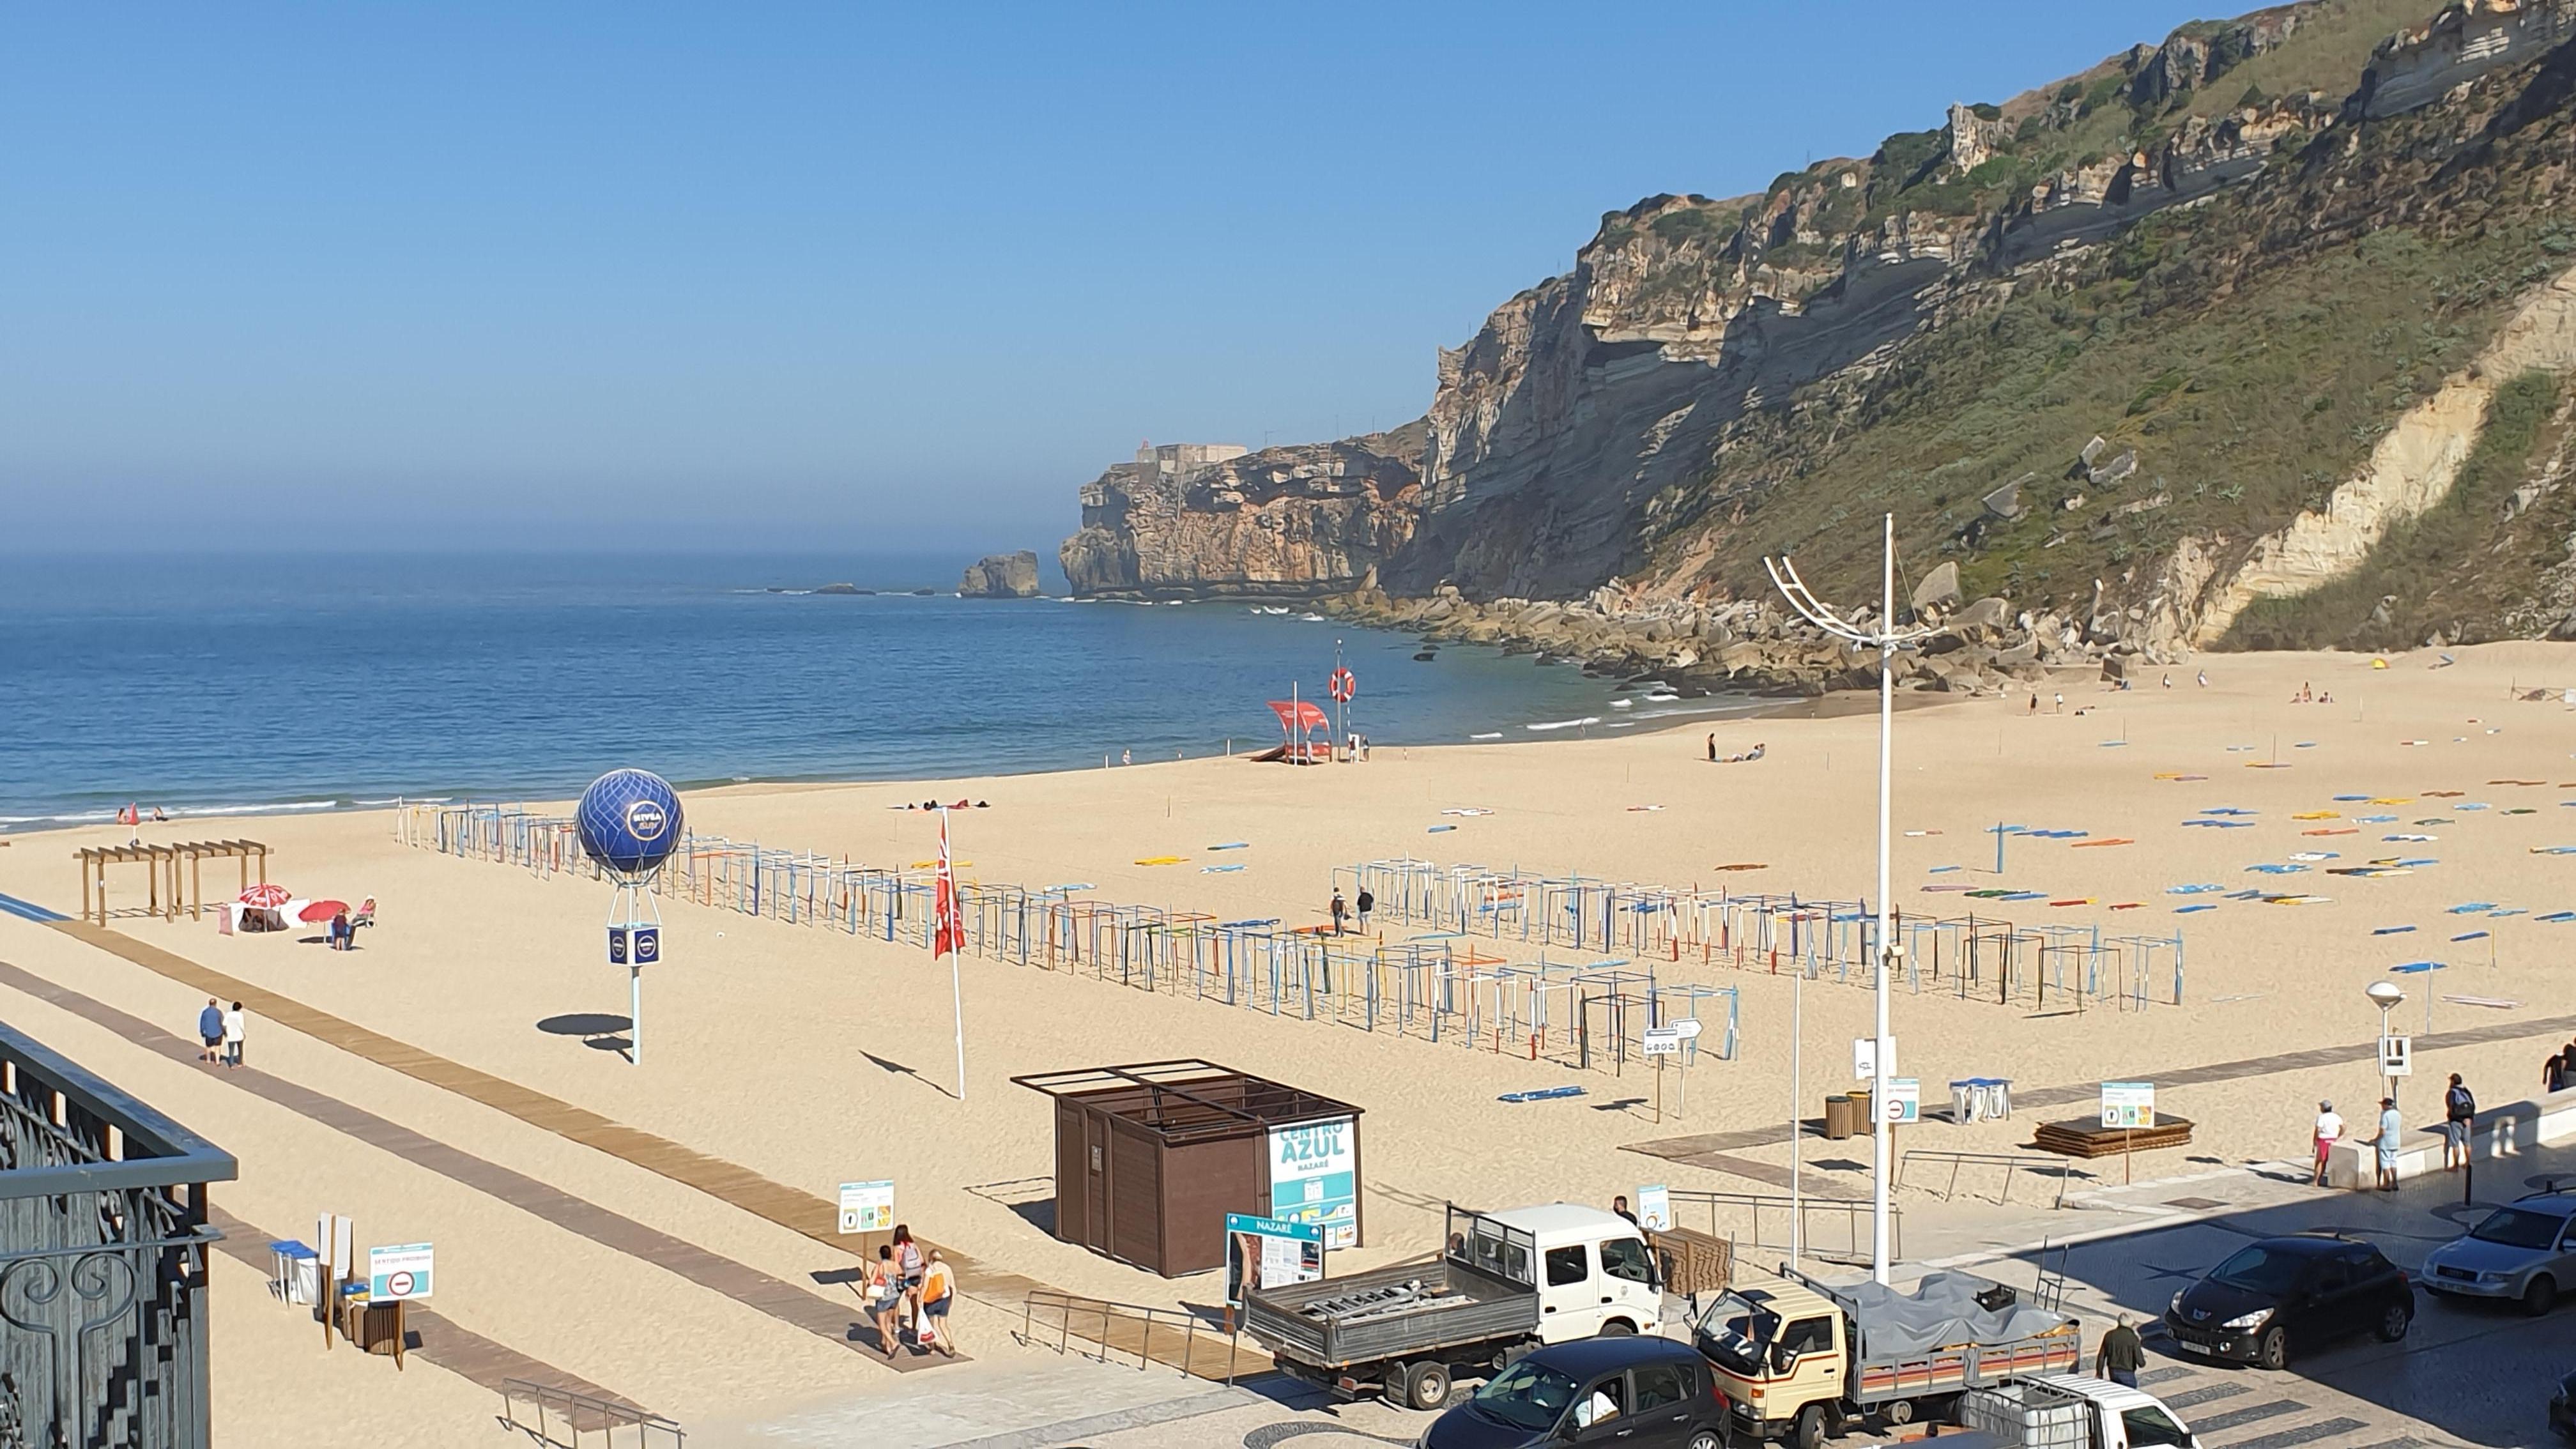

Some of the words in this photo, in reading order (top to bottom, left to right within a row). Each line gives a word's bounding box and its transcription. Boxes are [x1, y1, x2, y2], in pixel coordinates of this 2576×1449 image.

[633, 813, 662, 822] NIVEA
[1280, 1121, 1344, 1142] CENTRO
[1281, 1135, 1345, 1164] AZUL
[1298, 1159, 1329, 1172] NAZARÉ
[1256, 1220, 1292, 1234] NAZARÉ
